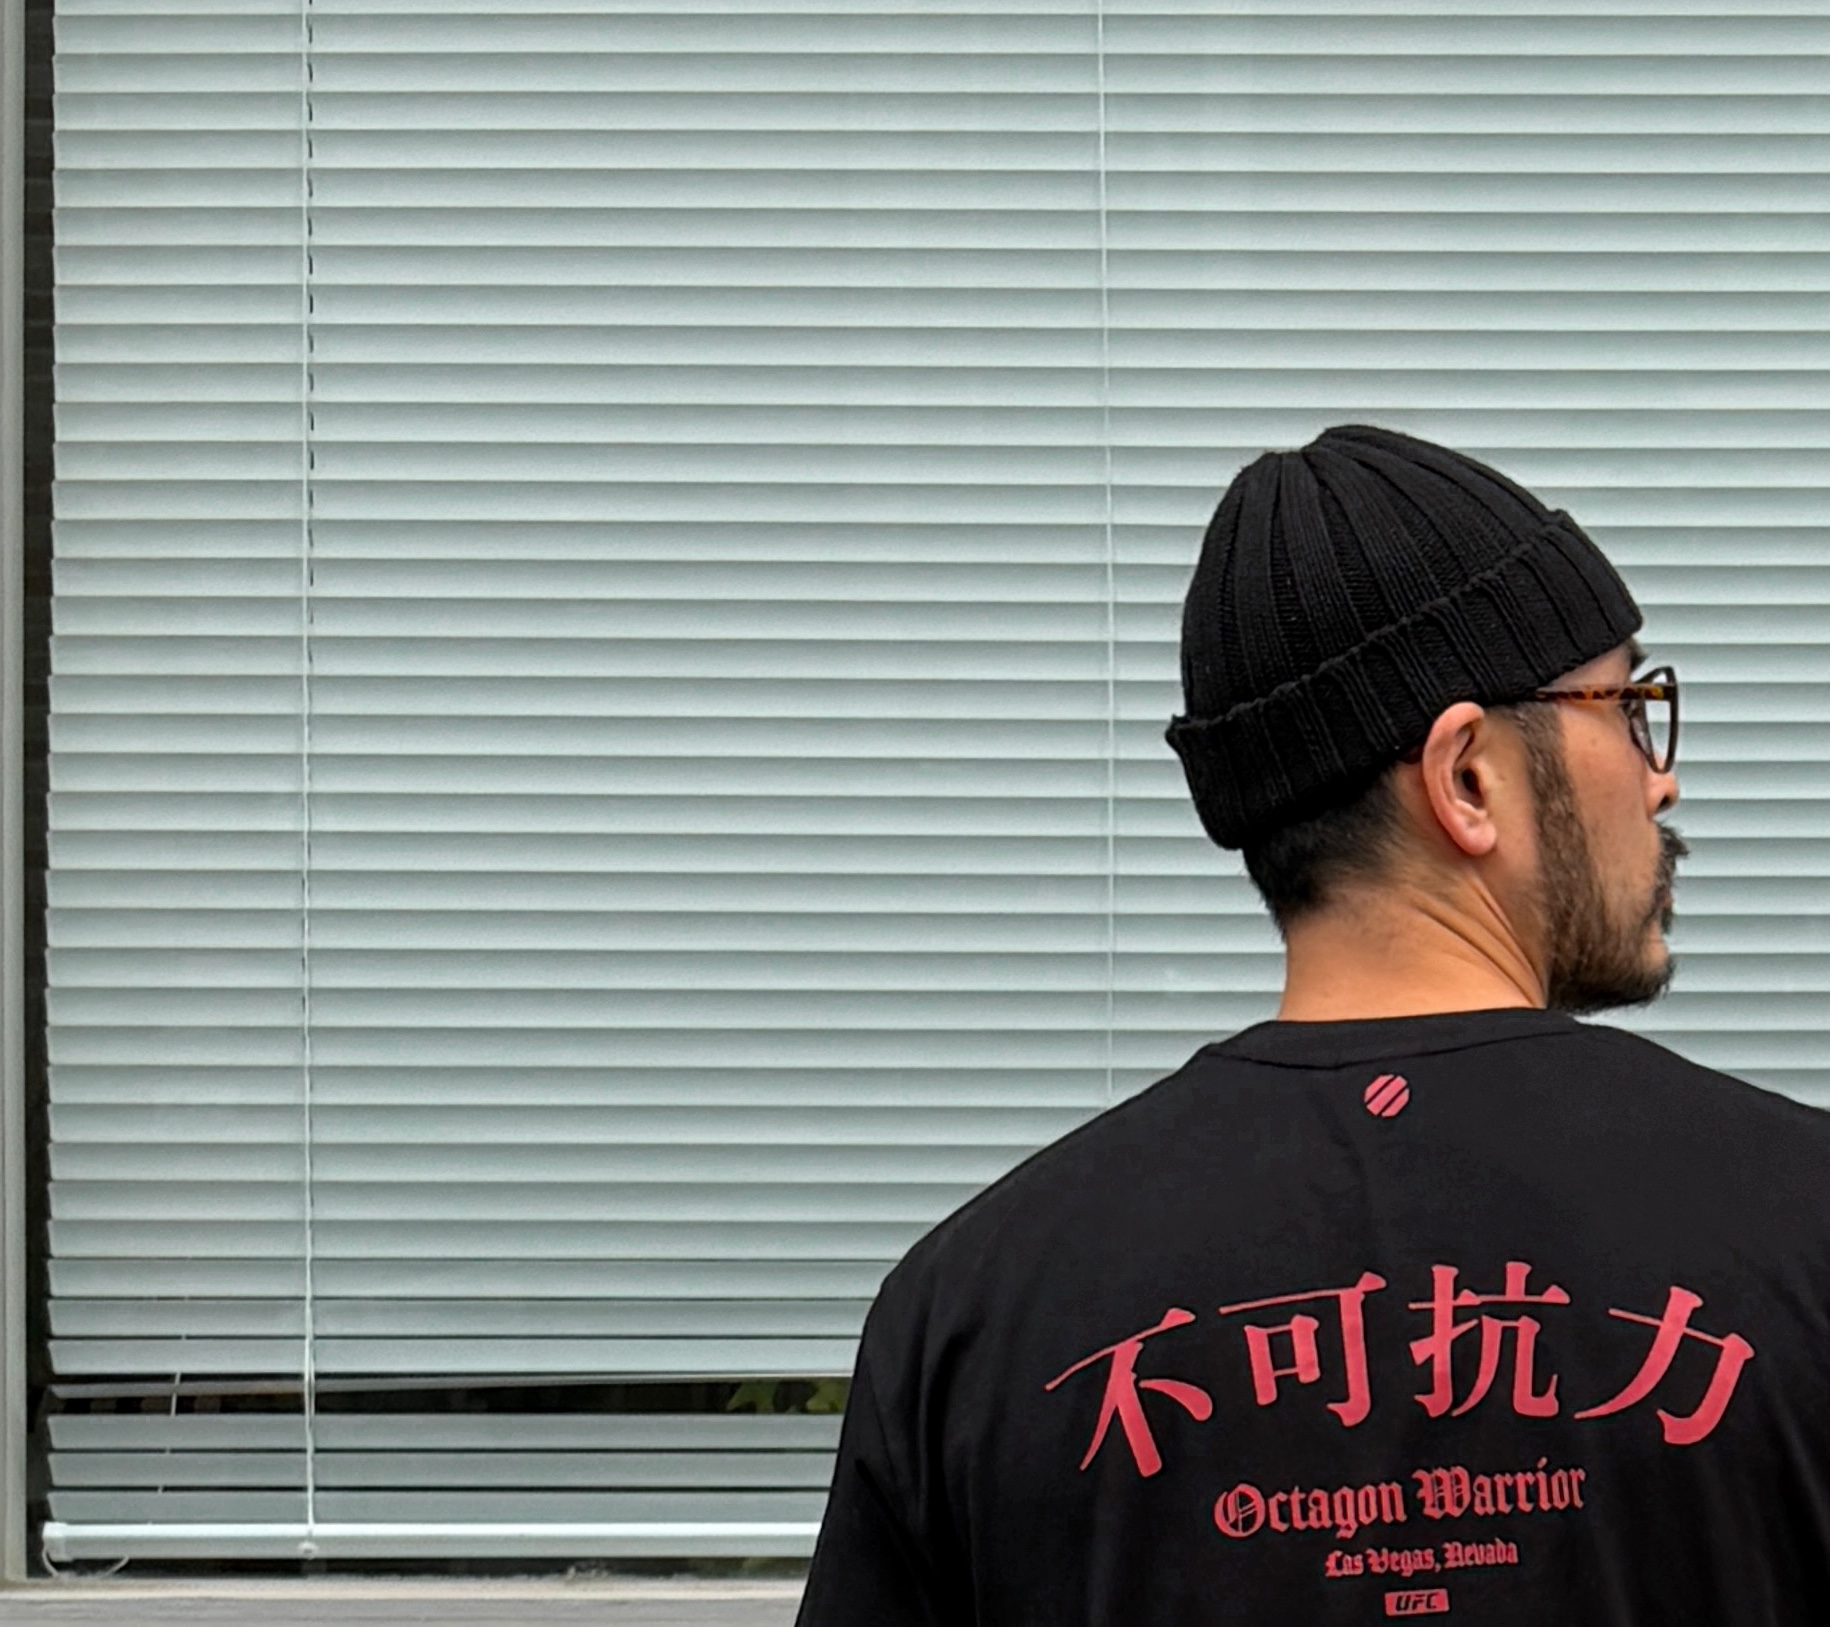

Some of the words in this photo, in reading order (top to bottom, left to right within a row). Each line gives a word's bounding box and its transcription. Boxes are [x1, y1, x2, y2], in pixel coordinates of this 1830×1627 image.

[1045, 1261, 1755, 1477] 不可抗力
[1212, 1482, 1406, 1540] Octagon
[1411, 1457, 1587, 1520] Warrior
[1324, 1550, 1364, 1577] Las
[1365, 1547, 1442, 1577] Vegas,
[1443, 1538, 1518, 1569] Nevada
[1394, 1593, 1440, 1611] UFC
